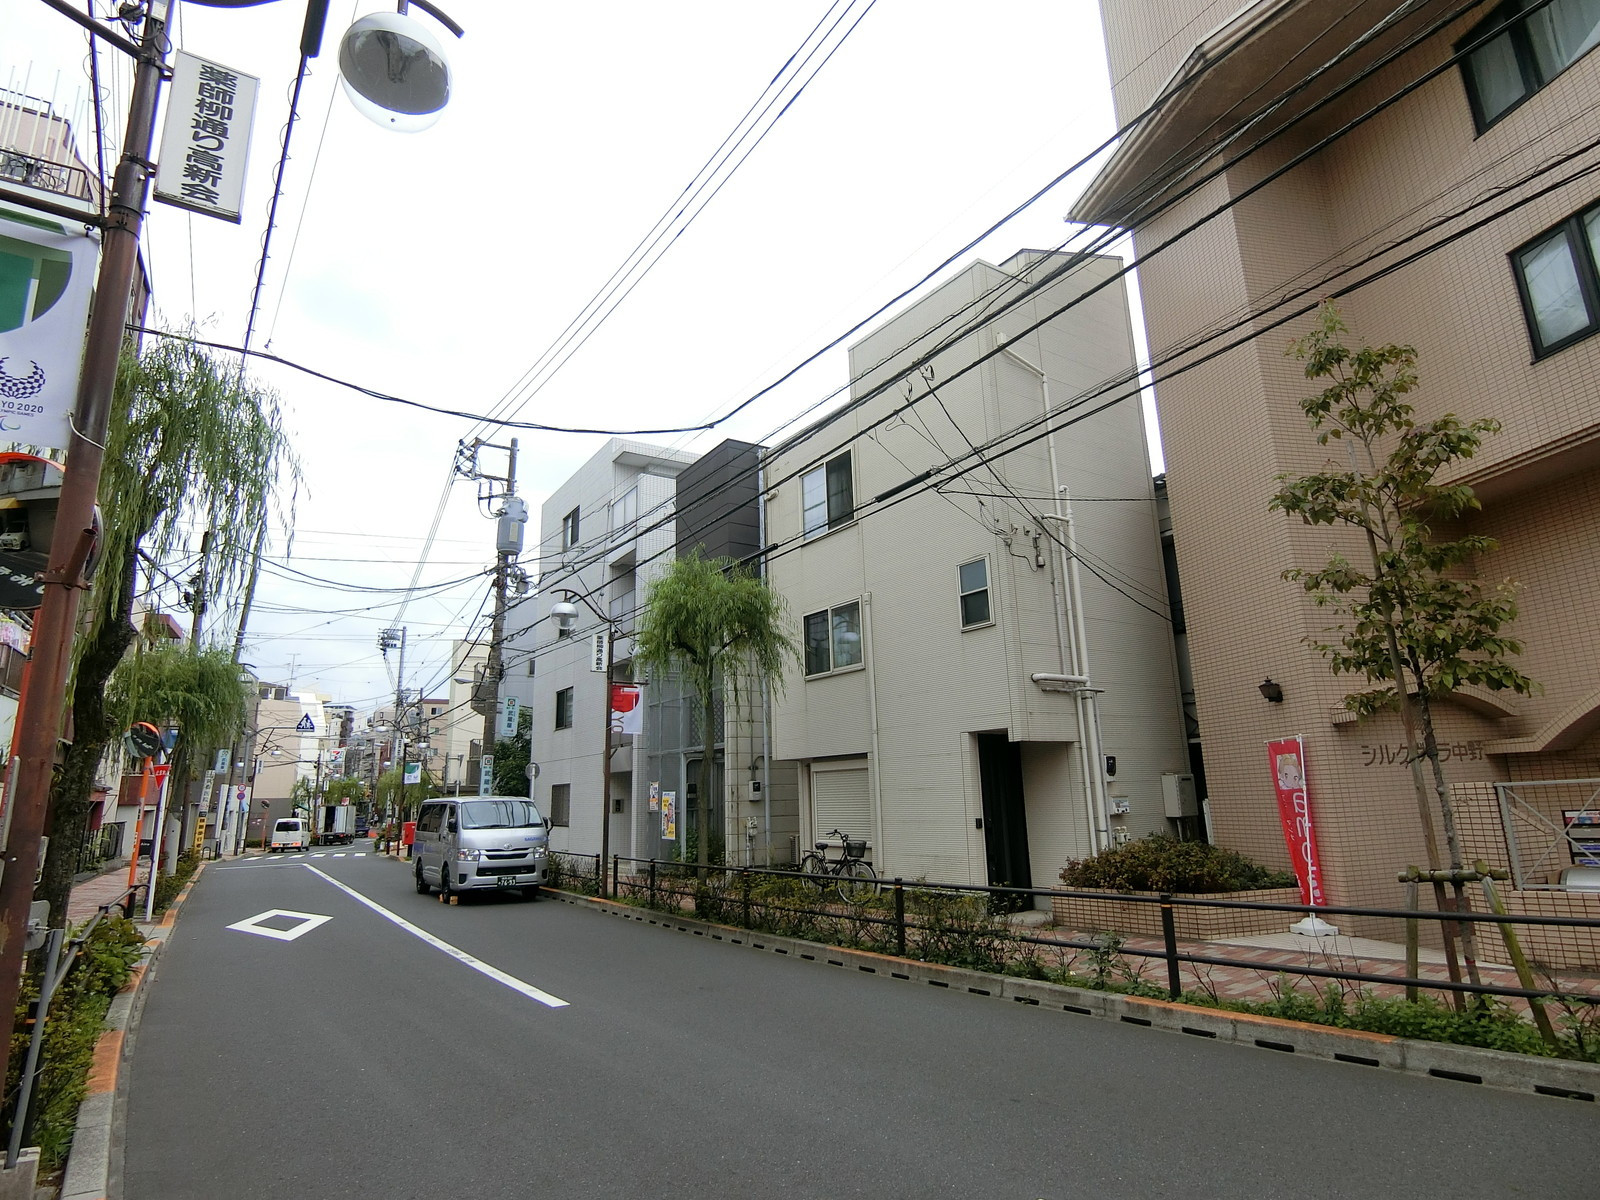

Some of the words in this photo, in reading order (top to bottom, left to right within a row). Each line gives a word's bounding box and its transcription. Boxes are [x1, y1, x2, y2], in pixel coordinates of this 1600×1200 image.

[180, 64, 238, 205] 薬師柳通り高新会
[17, 403, 44, 413] 2020
